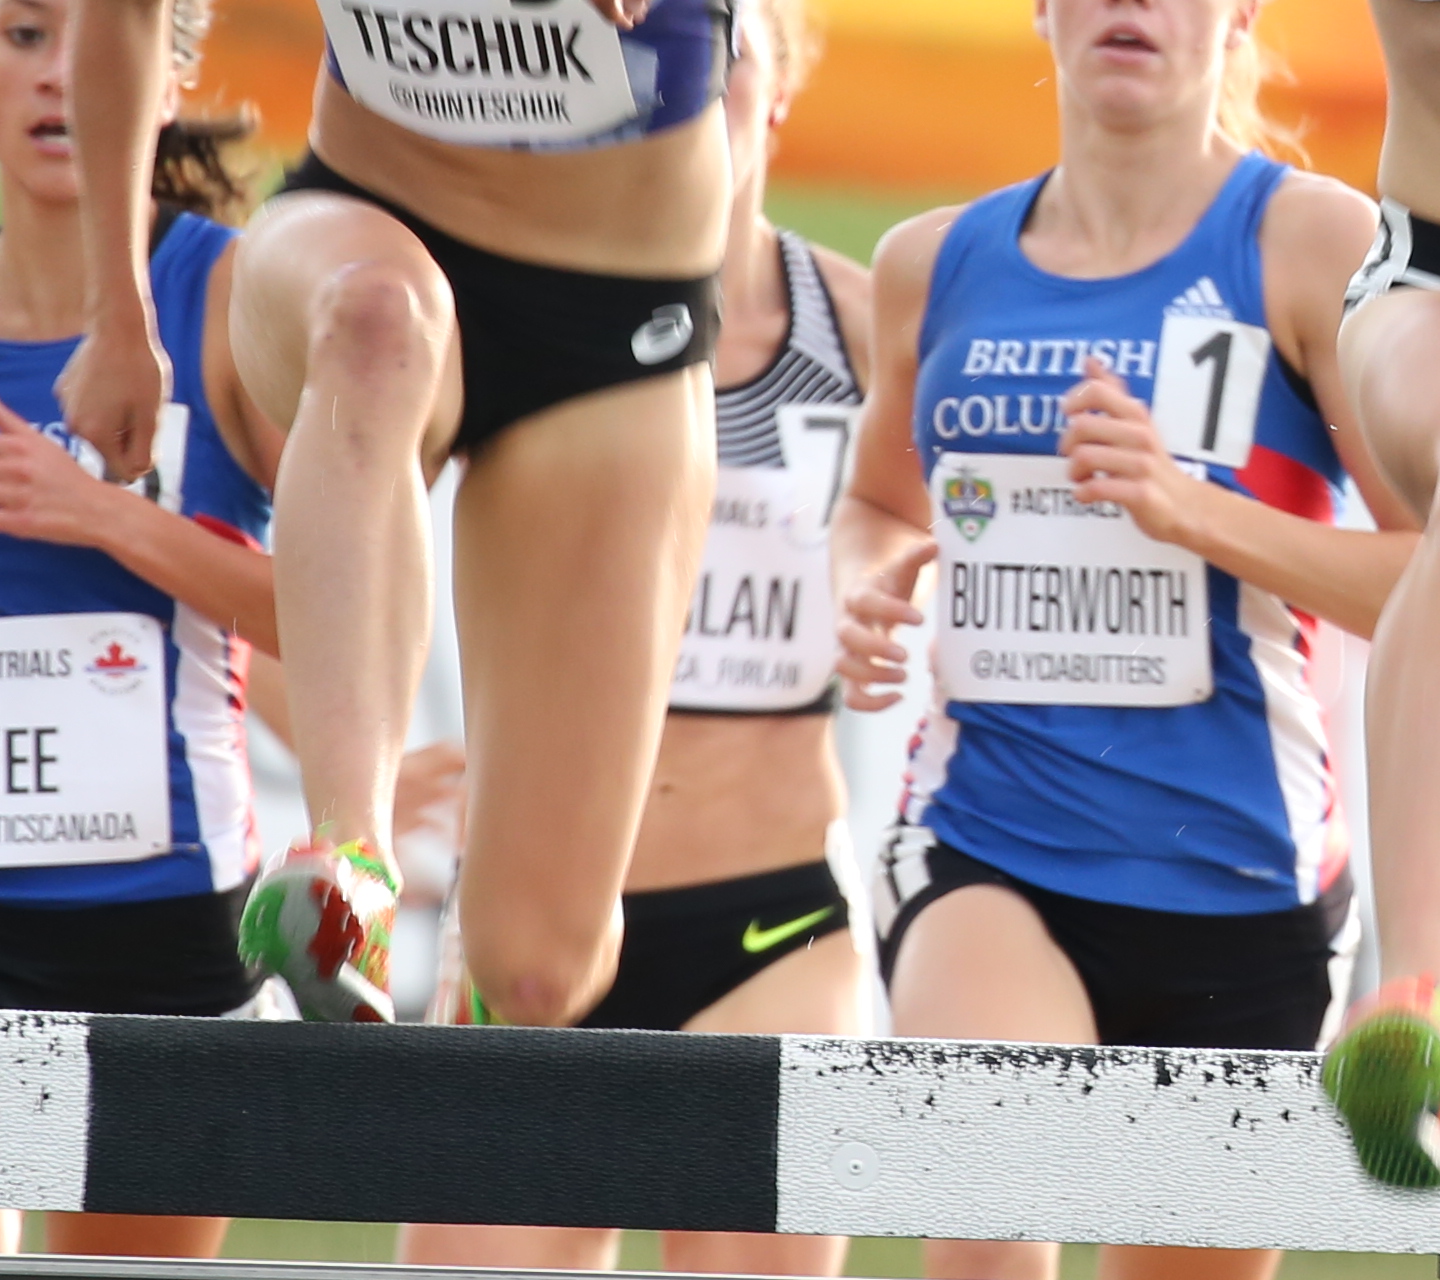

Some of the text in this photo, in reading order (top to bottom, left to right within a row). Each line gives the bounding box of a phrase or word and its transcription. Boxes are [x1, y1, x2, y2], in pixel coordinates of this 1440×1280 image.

[962, 337, 1157, 378] BRITISH
[1190, 330, 1234, 453] 1
[804, 417, 849, 528] 7
[685, 571, 800, 642] LAN
[950, 561, 1189, 637] BUTTERWORTH
